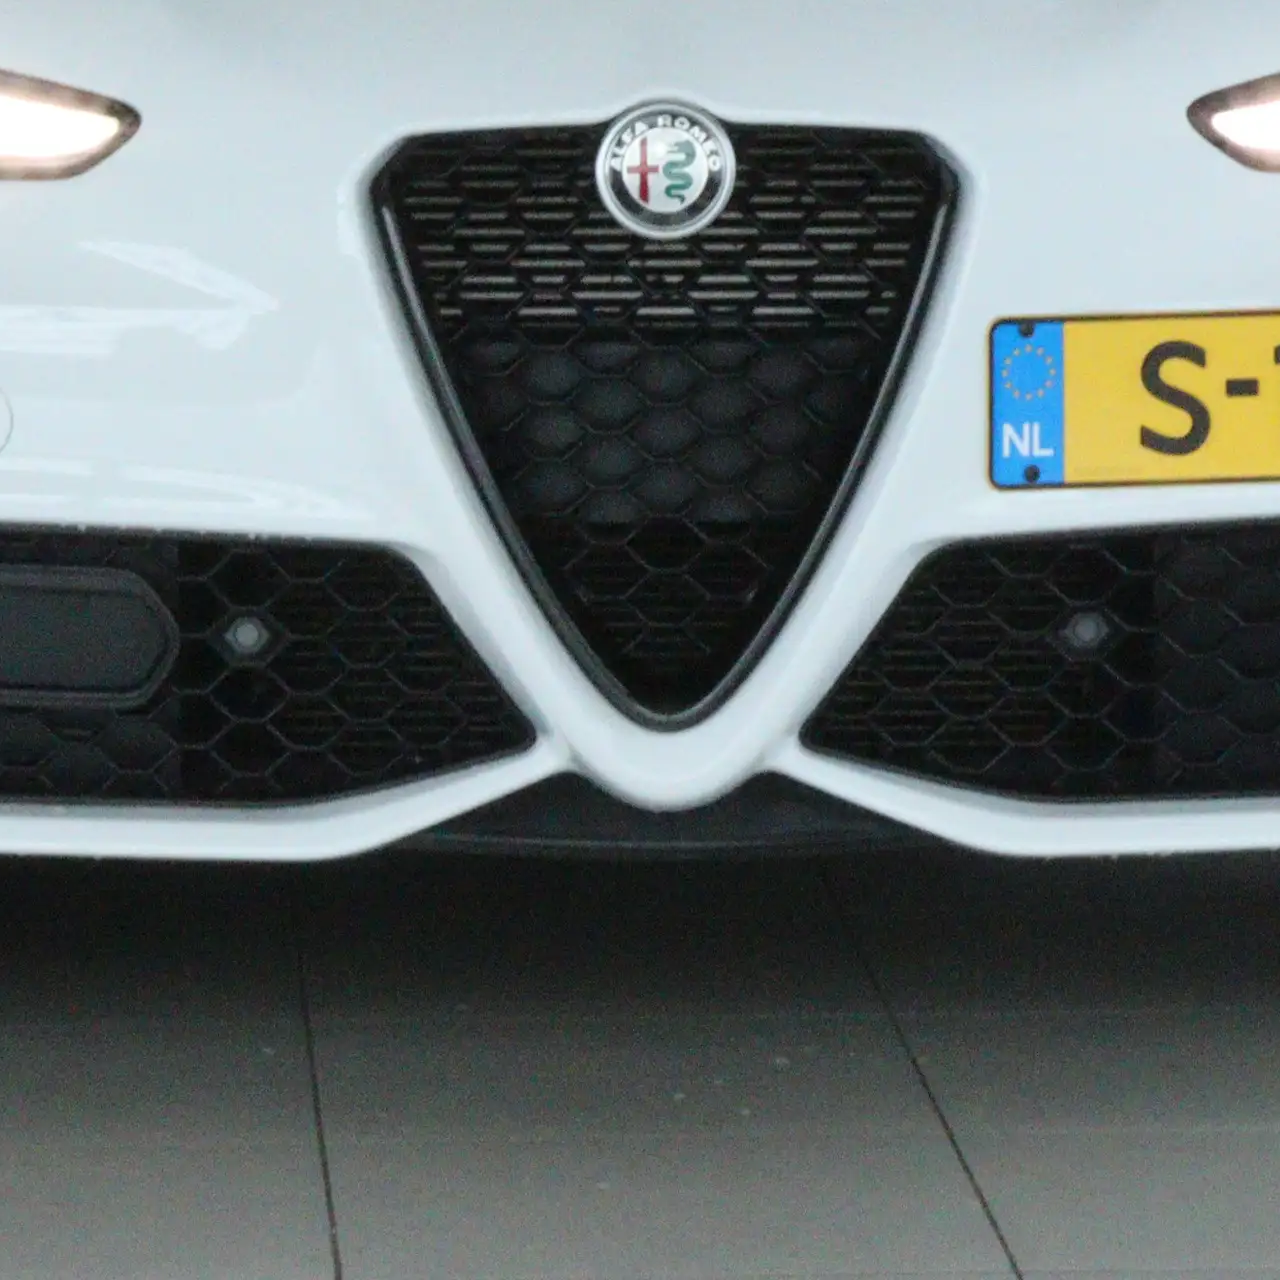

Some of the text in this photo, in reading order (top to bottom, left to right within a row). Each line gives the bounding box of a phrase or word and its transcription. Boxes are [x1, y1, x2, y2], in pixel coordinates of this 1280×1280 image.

[610, 113, 722, 173] ALFA ROMEO
[1002, 421, 1055, 458] NL
